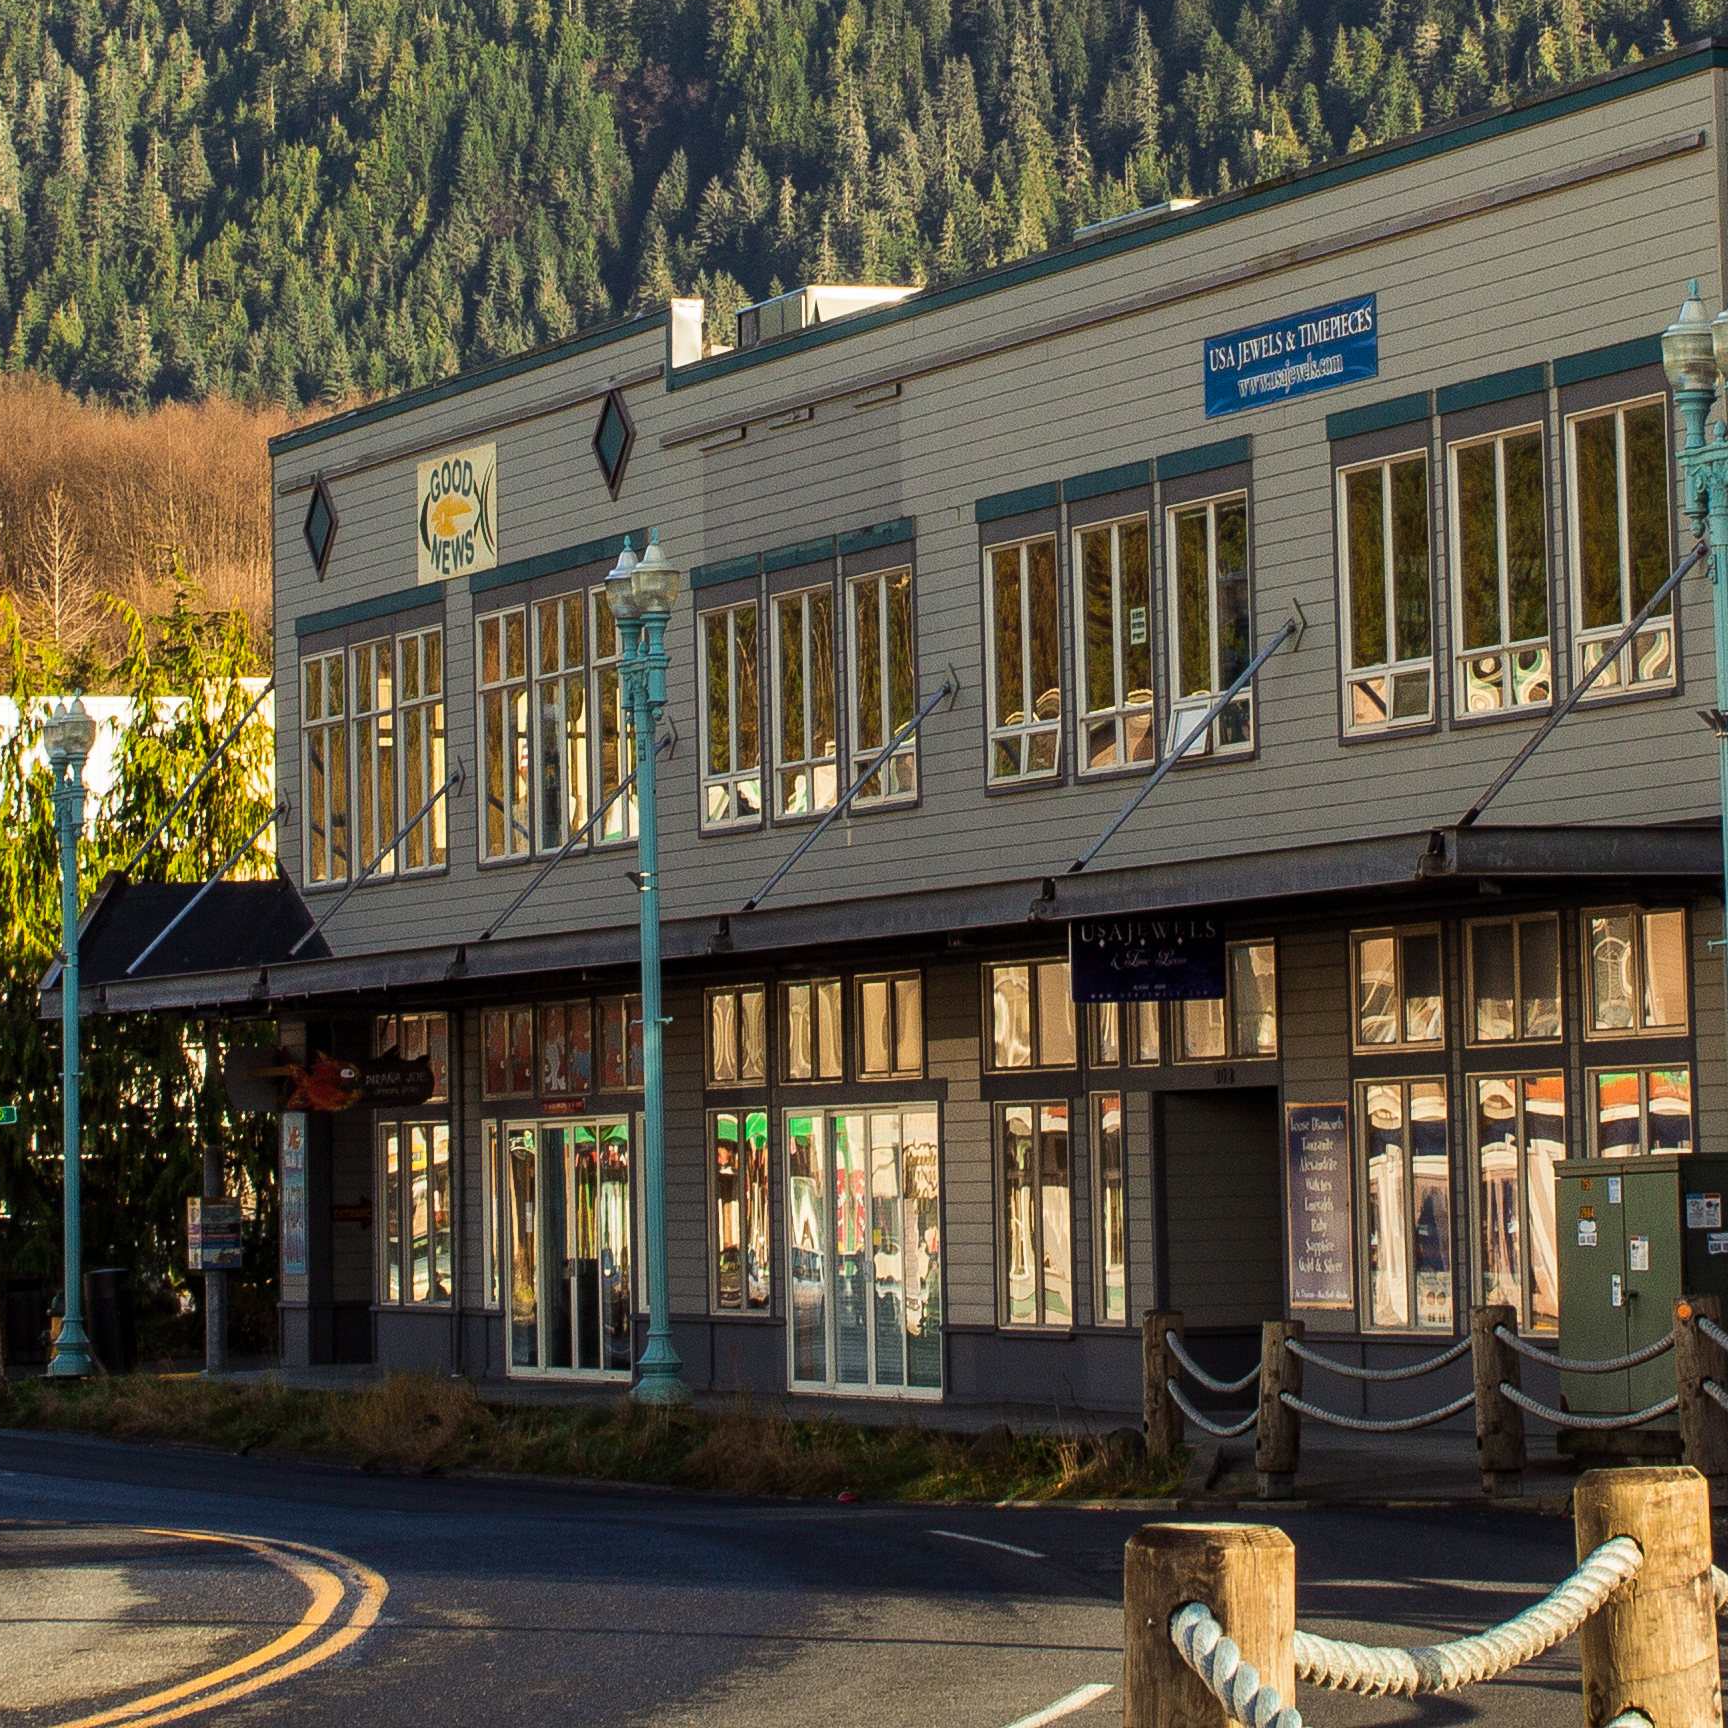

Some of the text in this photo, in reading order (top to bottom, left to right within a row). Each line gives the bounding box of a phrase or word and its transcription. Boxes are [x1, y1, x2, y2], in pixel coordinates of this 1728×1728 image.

[1209, 306, 1373, 372] USA JEWELS & TIMEPIECES
[1238, 352, 1344, 399] www.usajewels.com
[430, 458, 472, 503] GOOD
[430, 528, 475, 575] NEWS
